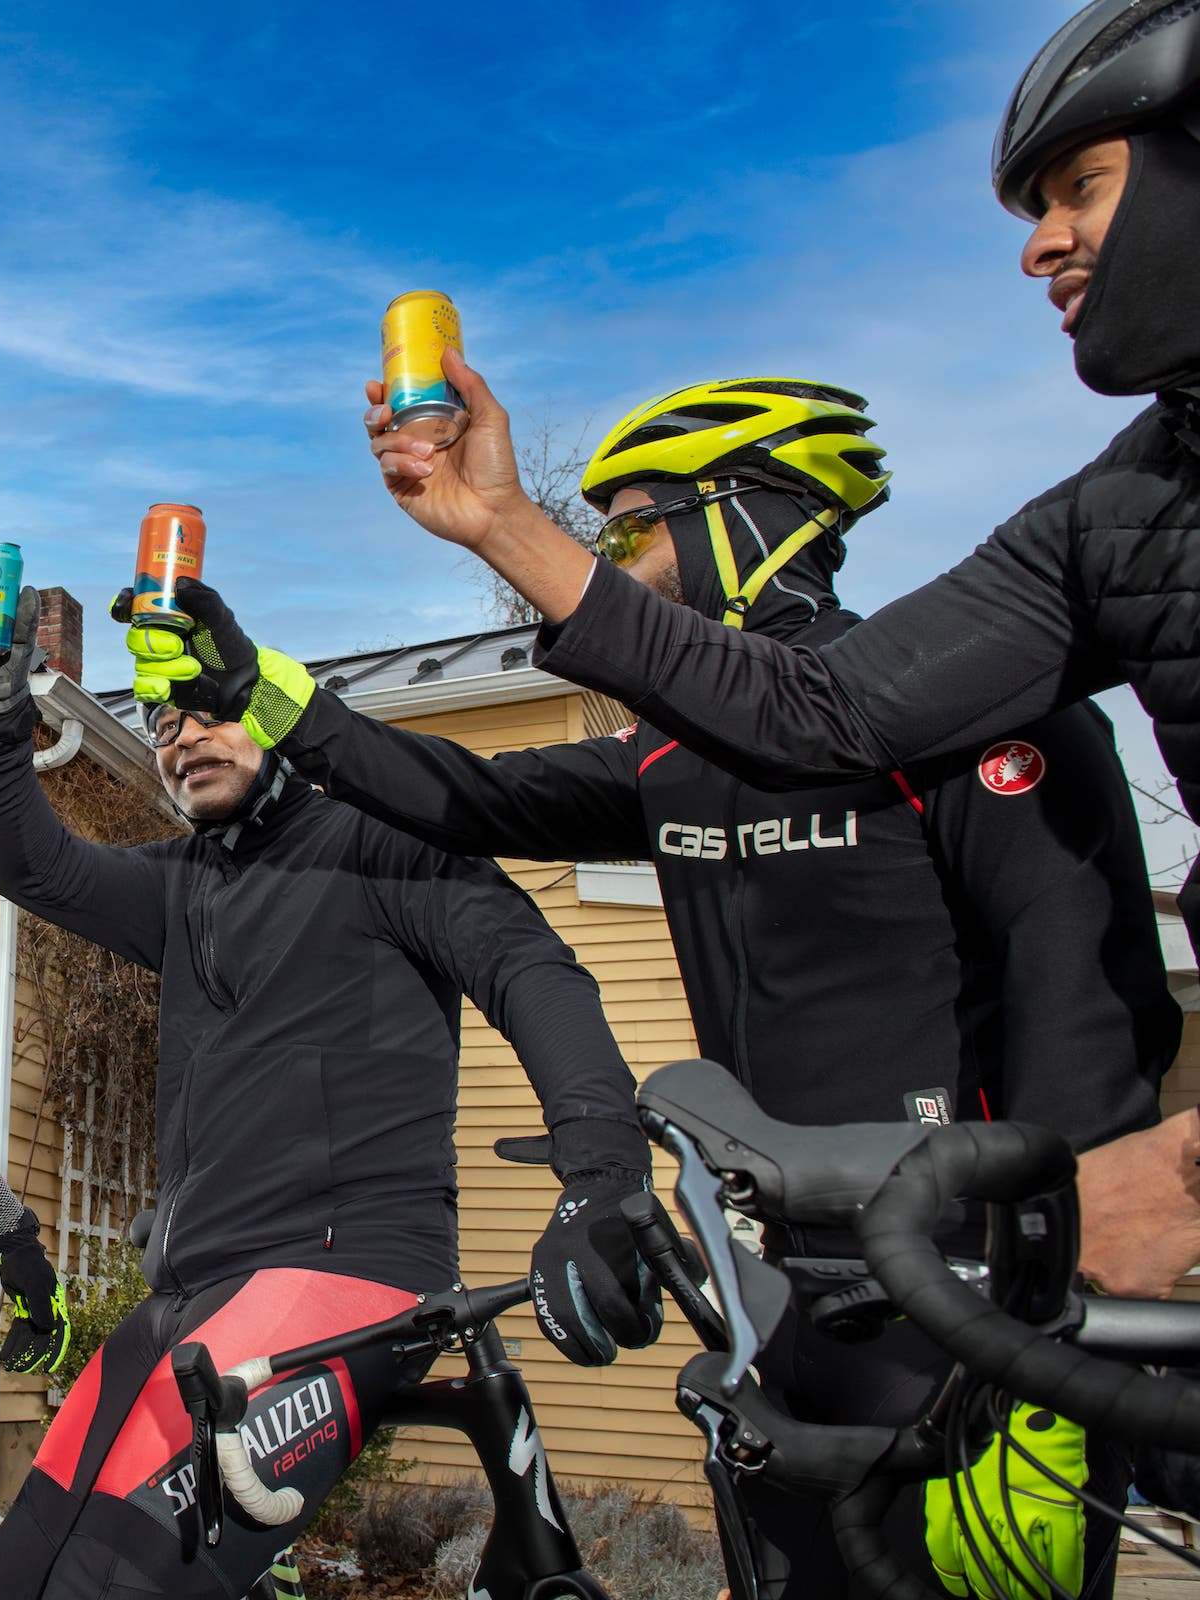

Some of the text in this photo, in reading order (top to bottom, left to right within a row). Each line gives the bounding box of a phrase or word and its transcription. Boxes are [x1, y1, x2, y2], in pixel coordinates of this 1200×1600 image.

[177, 555, 194, 565] WAVE
[534, 1286, 568, 1341] CRAFT
[273, 1420, 339, 1477] racing
